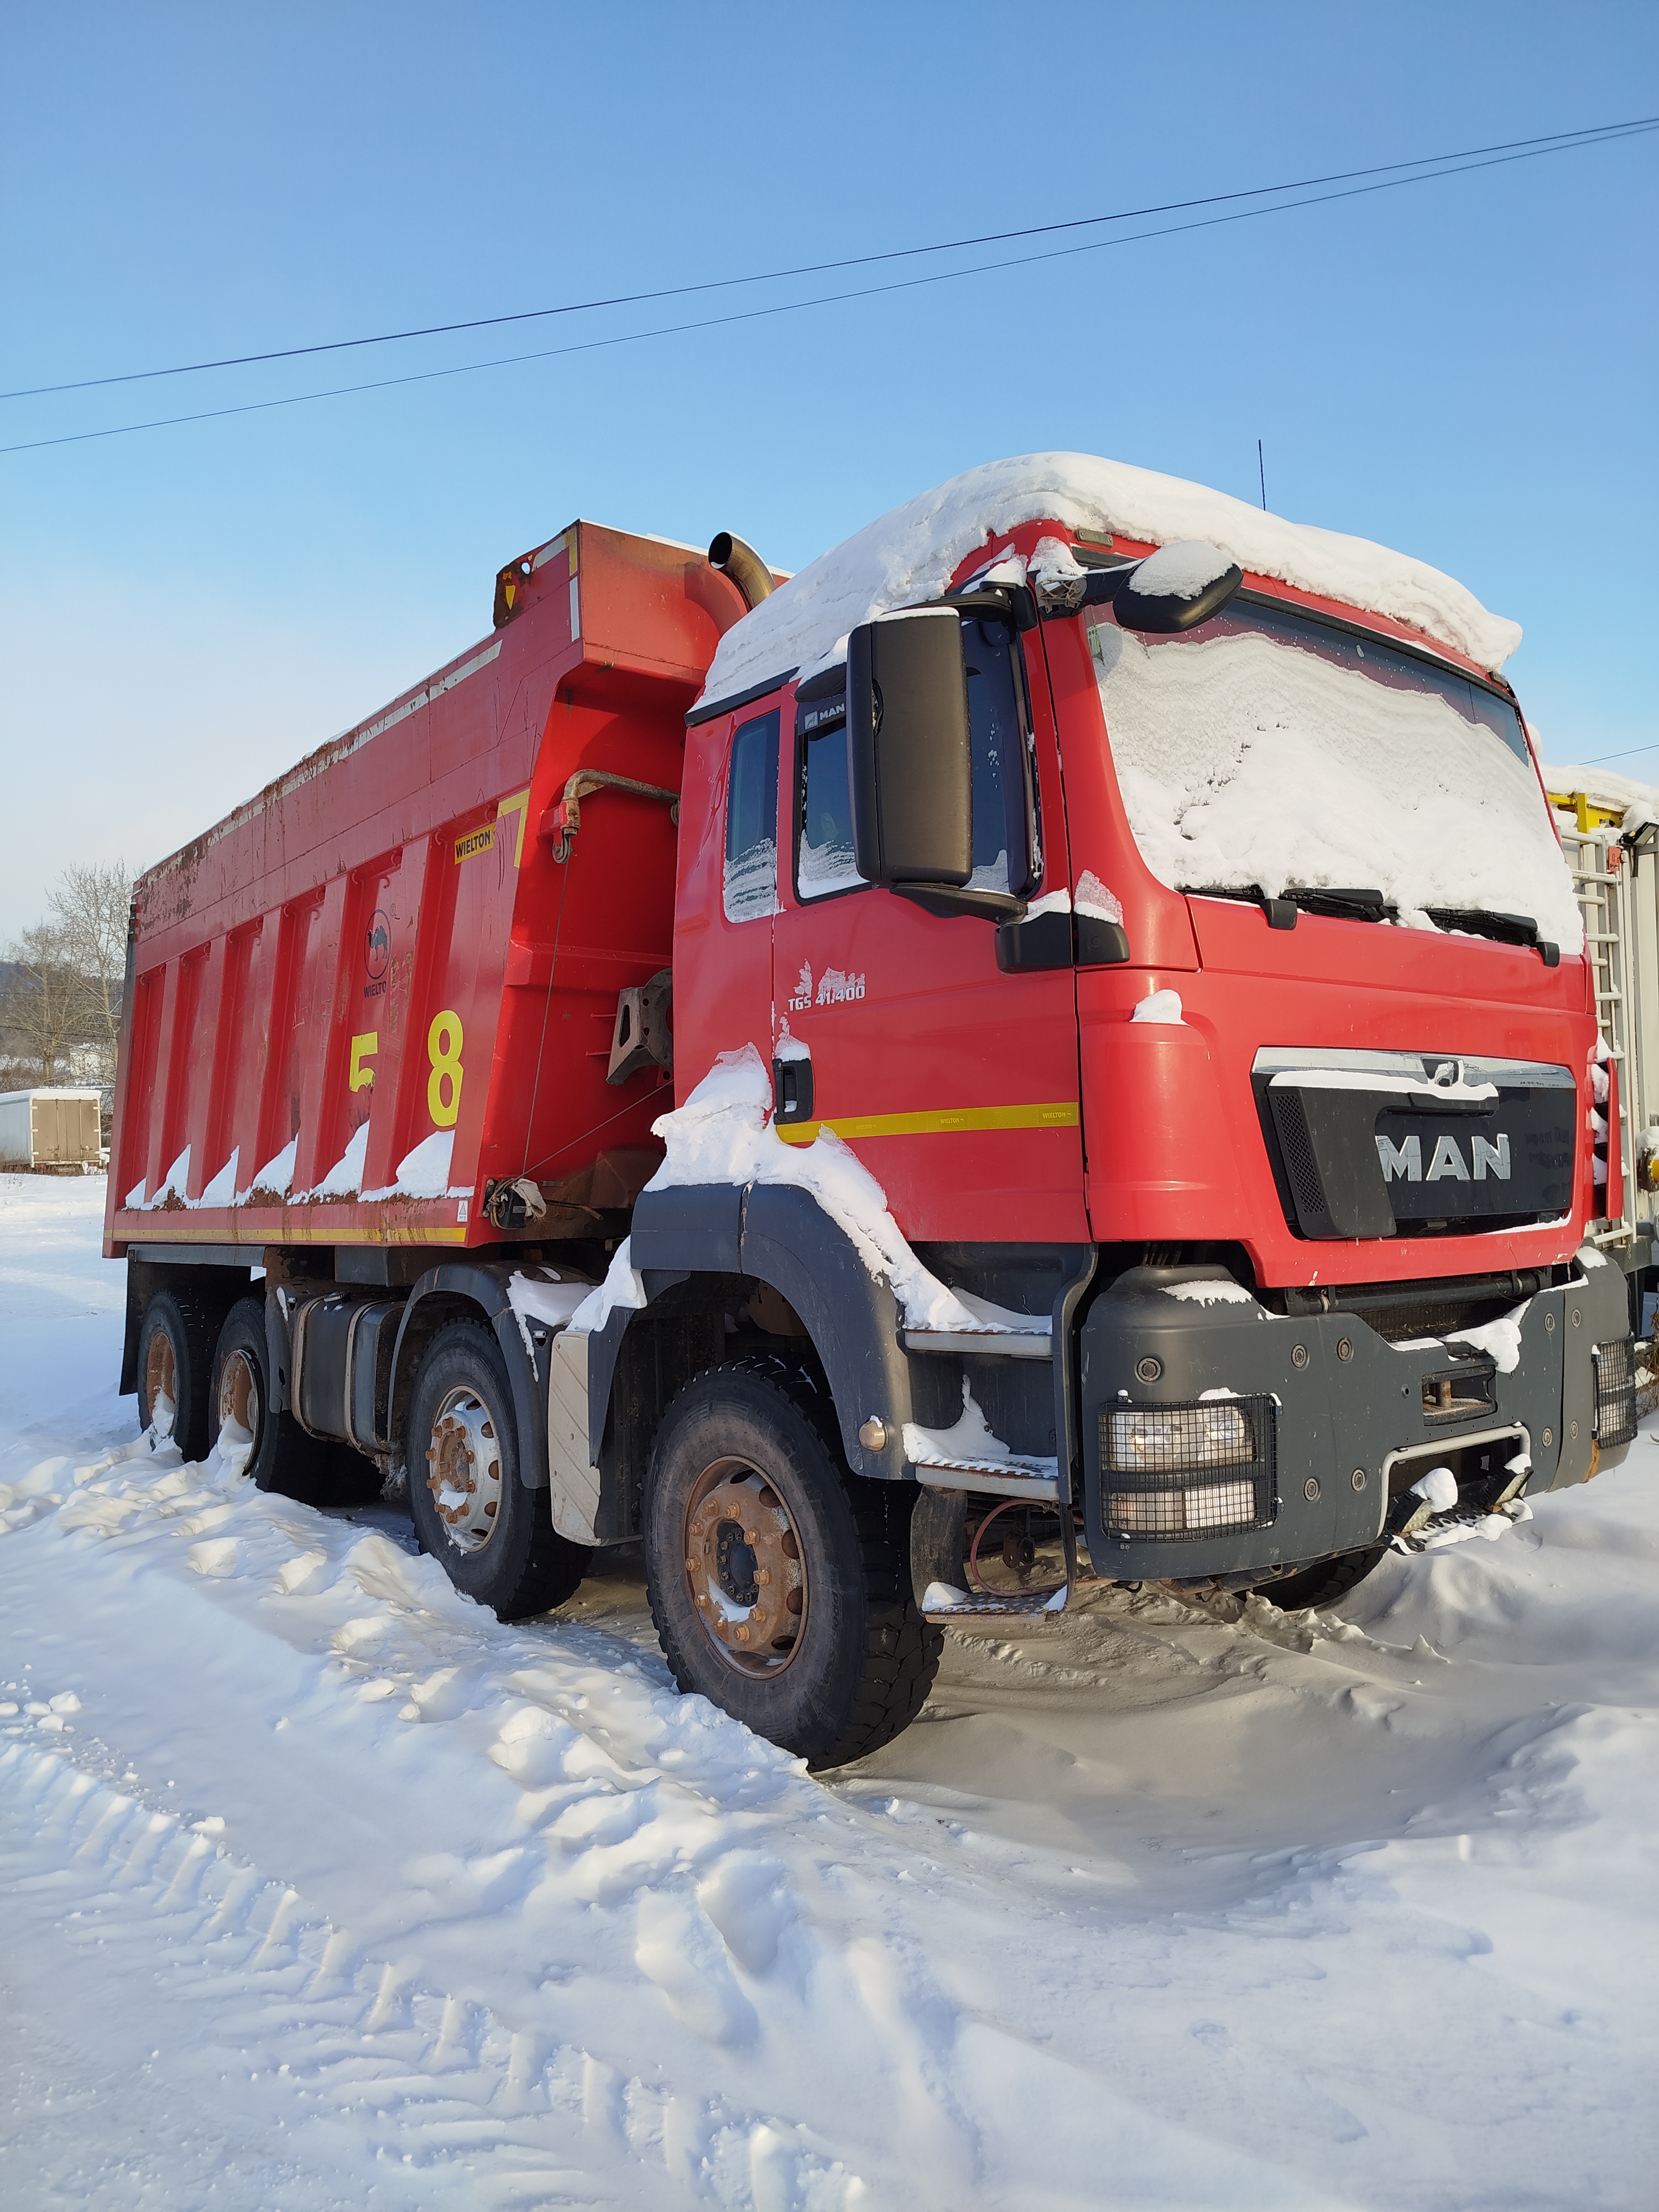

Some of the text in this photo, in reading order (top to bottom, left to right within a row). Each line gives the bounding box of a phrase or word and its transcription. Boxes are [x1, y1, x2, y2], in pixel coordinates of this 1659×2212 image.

[820, 703, 845, 721] MAN
[456, 830, 491, 859] WIELTON
[364, 980, 387, 998] WIELTO
[787, 985, 866, 1011] TGS 41.400
[427, 1010, 464, 1127] 8
[1375, 1134, 1510, 1181] MAN
